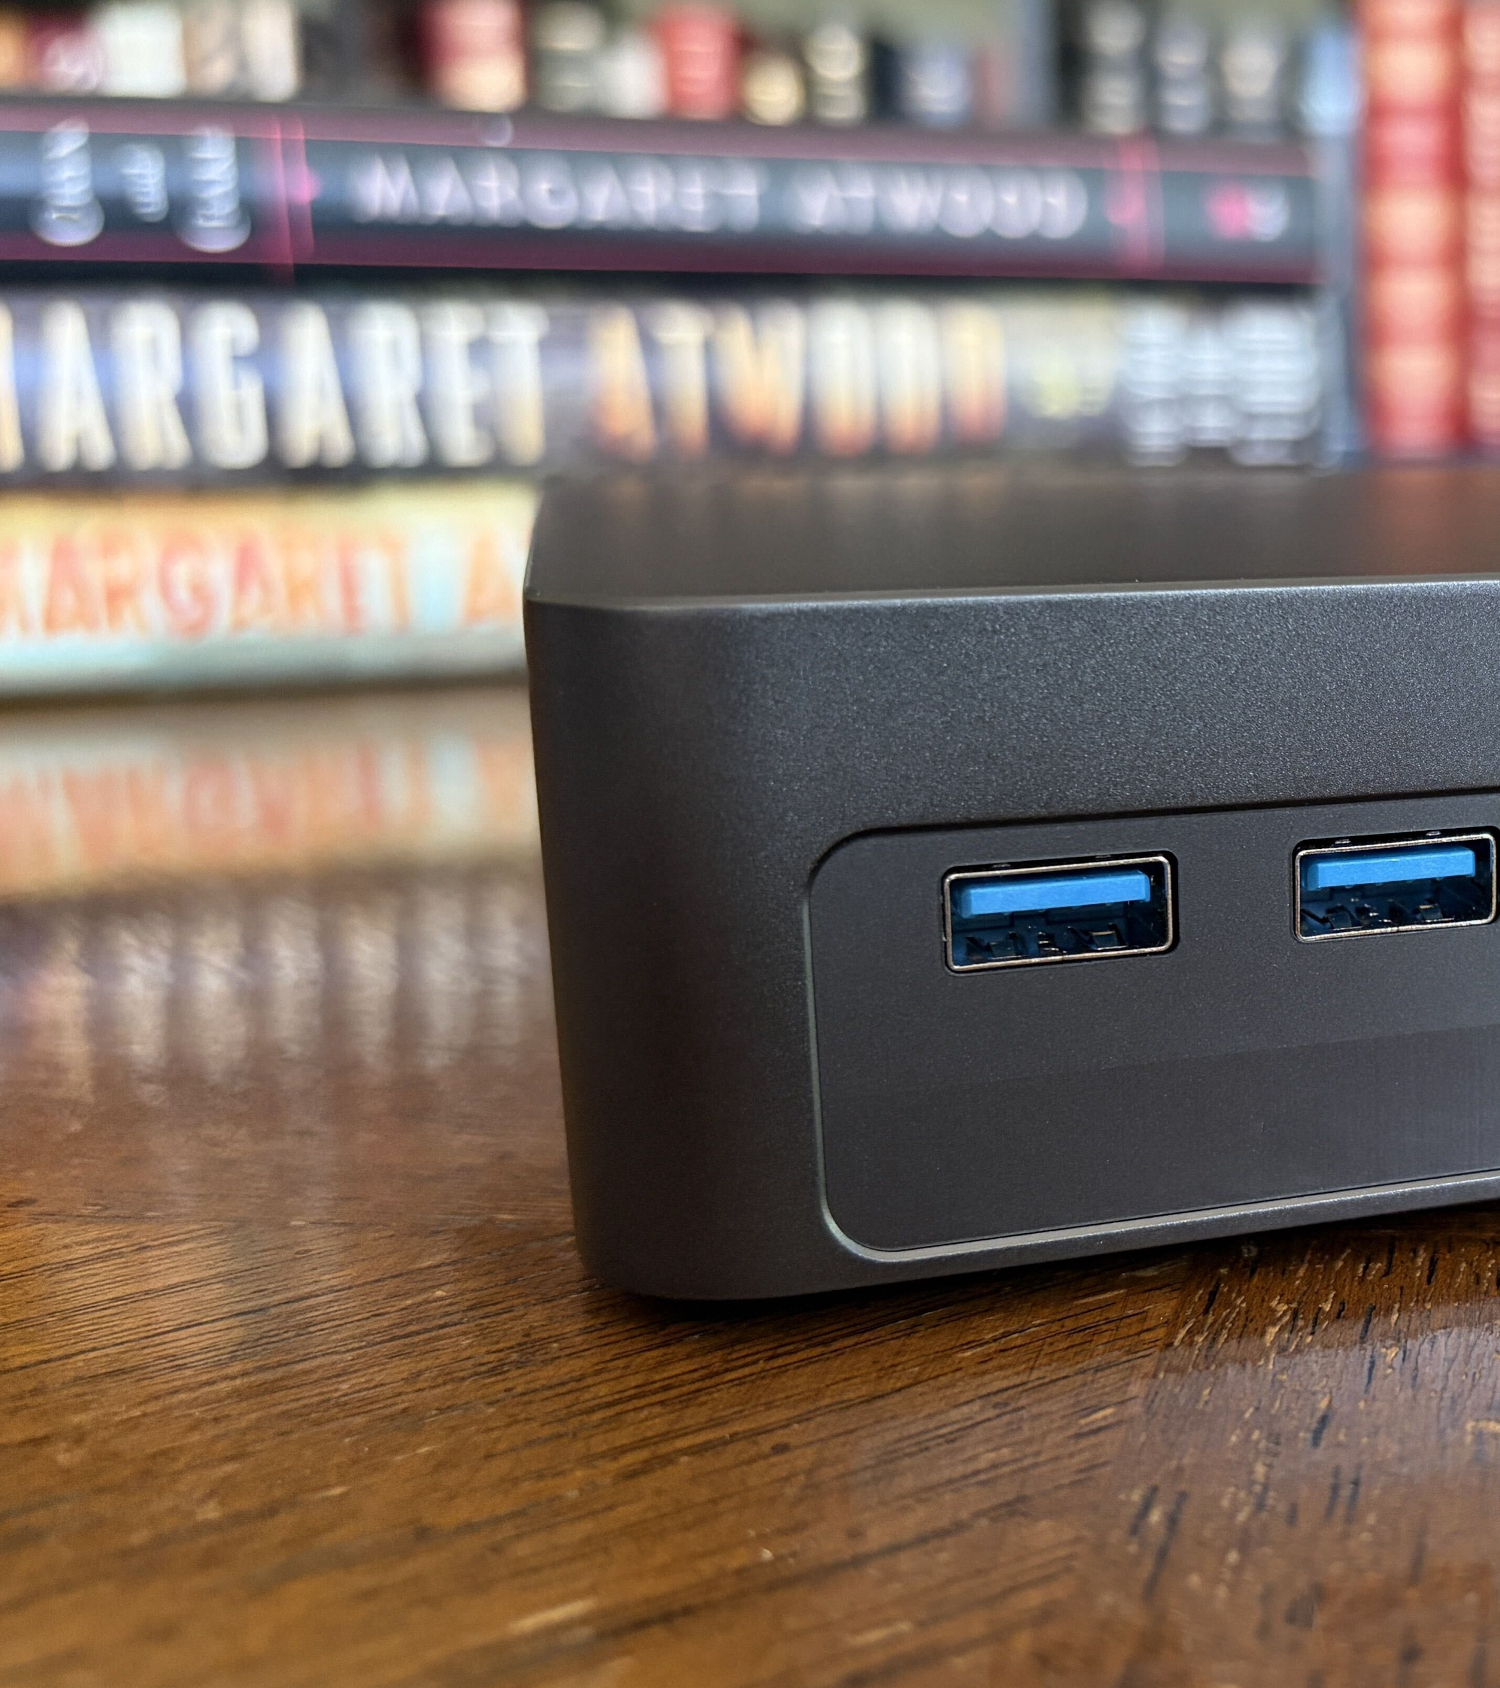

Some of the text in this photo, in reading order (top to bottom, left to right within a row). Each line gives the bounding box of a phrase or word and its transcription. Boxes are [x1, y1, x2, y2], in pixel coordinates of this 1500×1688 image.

[348, 150, 1089, 240] MARGARET ATWOOD
[0, 300, 547, 474] ARGARET
[588, 306, 1006, 460] ATWOOD
